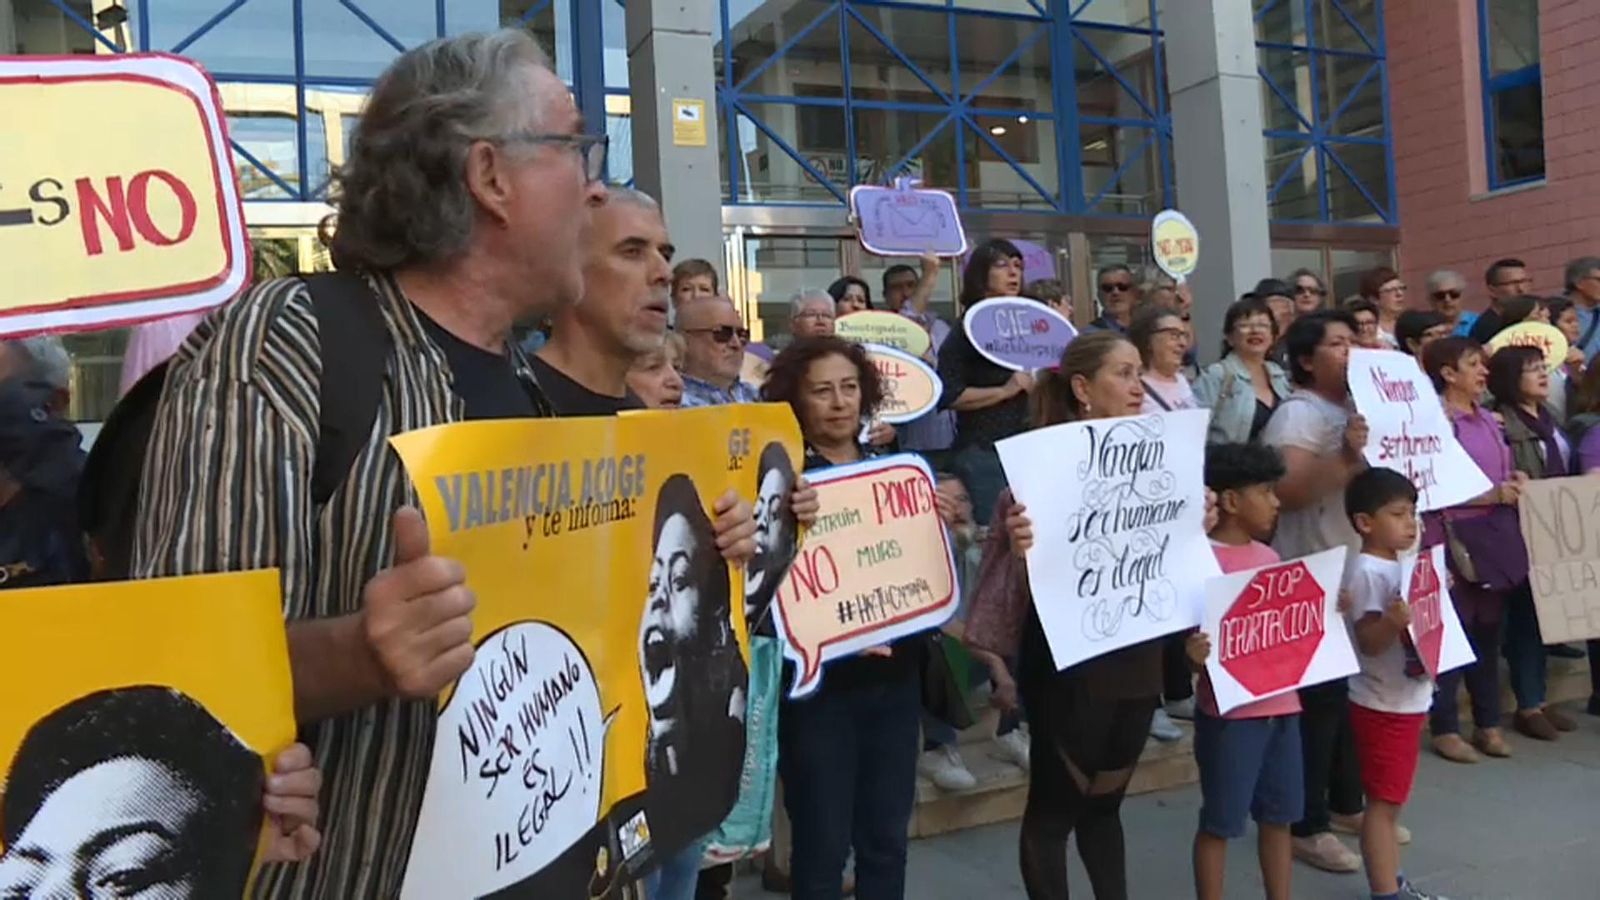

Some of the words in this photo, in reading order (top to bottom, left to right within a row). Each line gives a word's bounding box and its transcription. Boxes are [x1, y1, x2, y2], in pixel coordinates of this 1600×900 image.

[74, 168, 198, 256] NO
[994, 308, 1032, 338] CIE
[1031, 318, 1050, 335] NO
[434, 460, 572, 533] VALENCIA
[580, 453, 646, 506] ACOGE
[872, 476, 933, 525] PONTS
[1525, 486, 1586, 564] NO
[522, 510, 536, 551] y
[542, 508, 561, 538] te
[789, 545, 840, 603] NO
[856, 538, 903, 569] MURS
[1248, 566, 1305, 609] STOP
[518, 653, 580, 747] HUMANO
